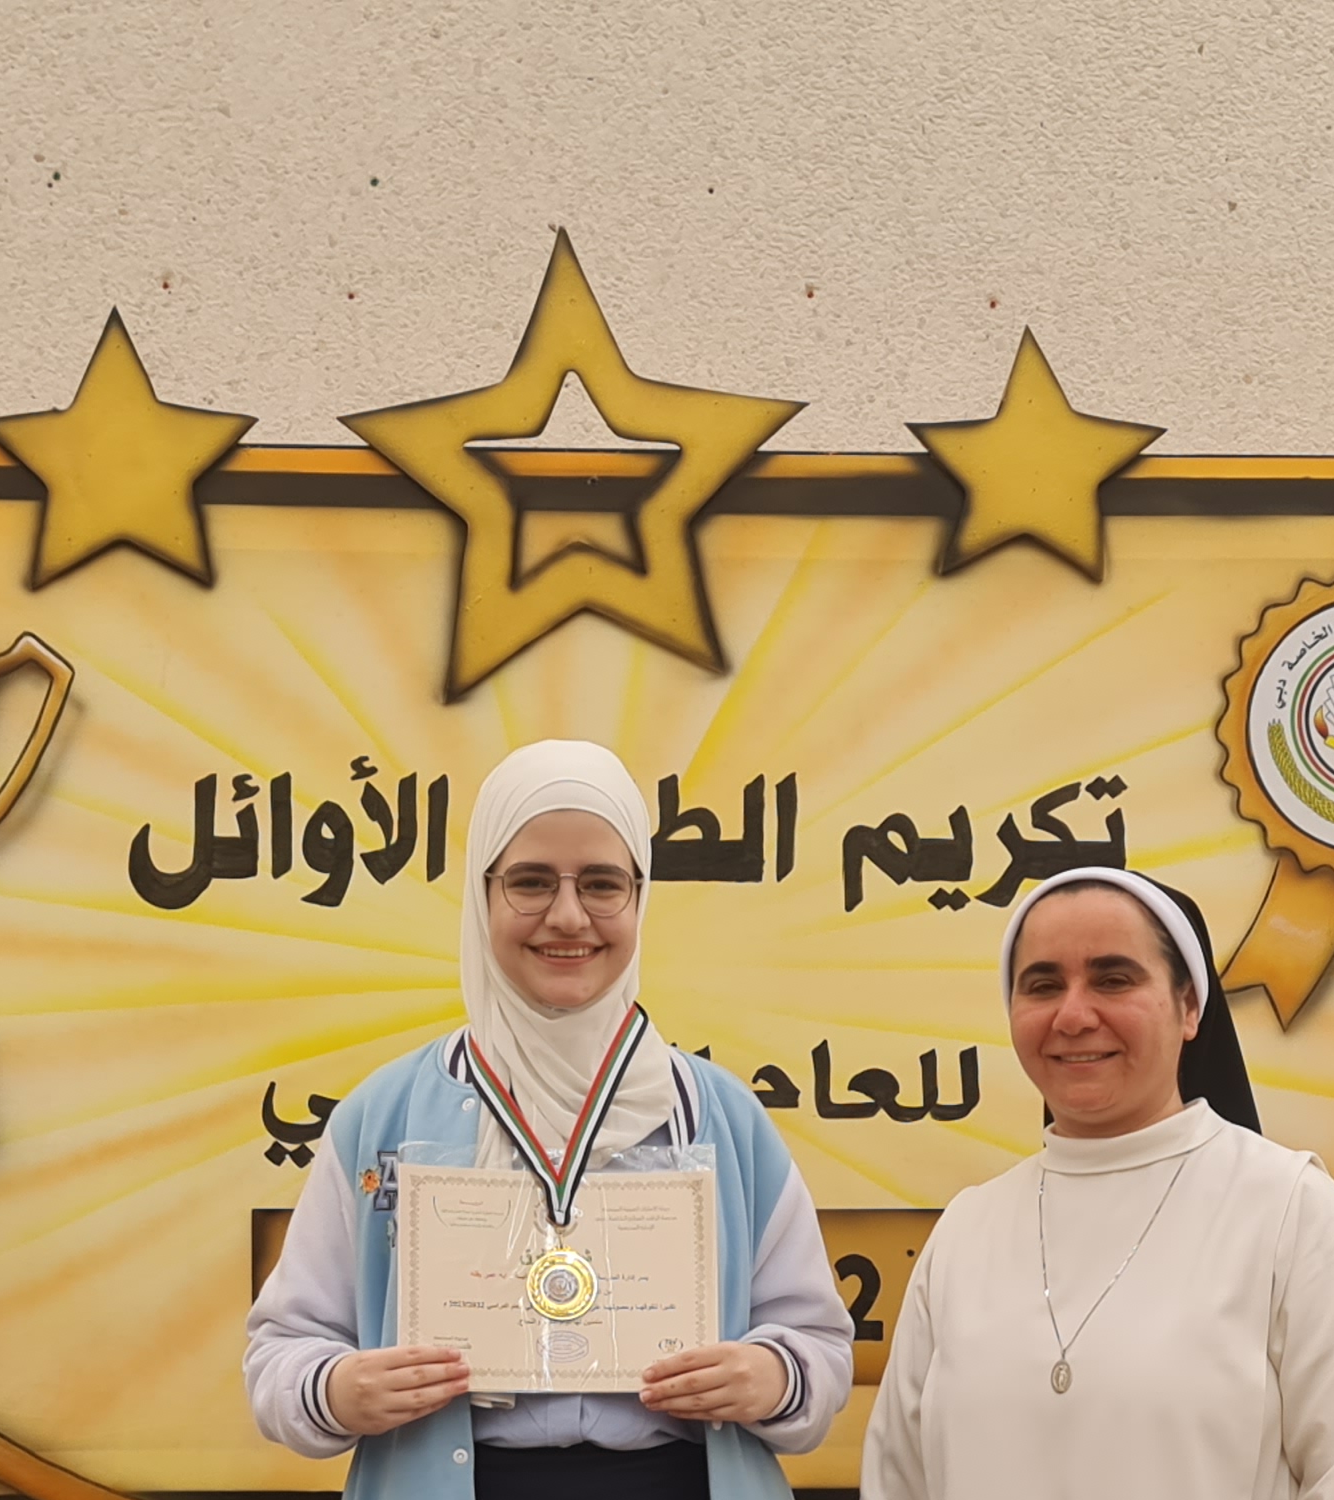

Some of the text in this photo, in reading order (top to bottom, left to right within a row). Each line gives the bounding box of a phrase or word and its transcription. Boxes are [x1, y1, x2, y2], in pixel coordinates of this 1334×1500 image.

[1281, 624, 1333, 670] الخاصة
[1275, 679, 1287, 709] دبي
[128, 755, 448, 910] الأوائل
[841, 774, 1128, 912] تكريم
